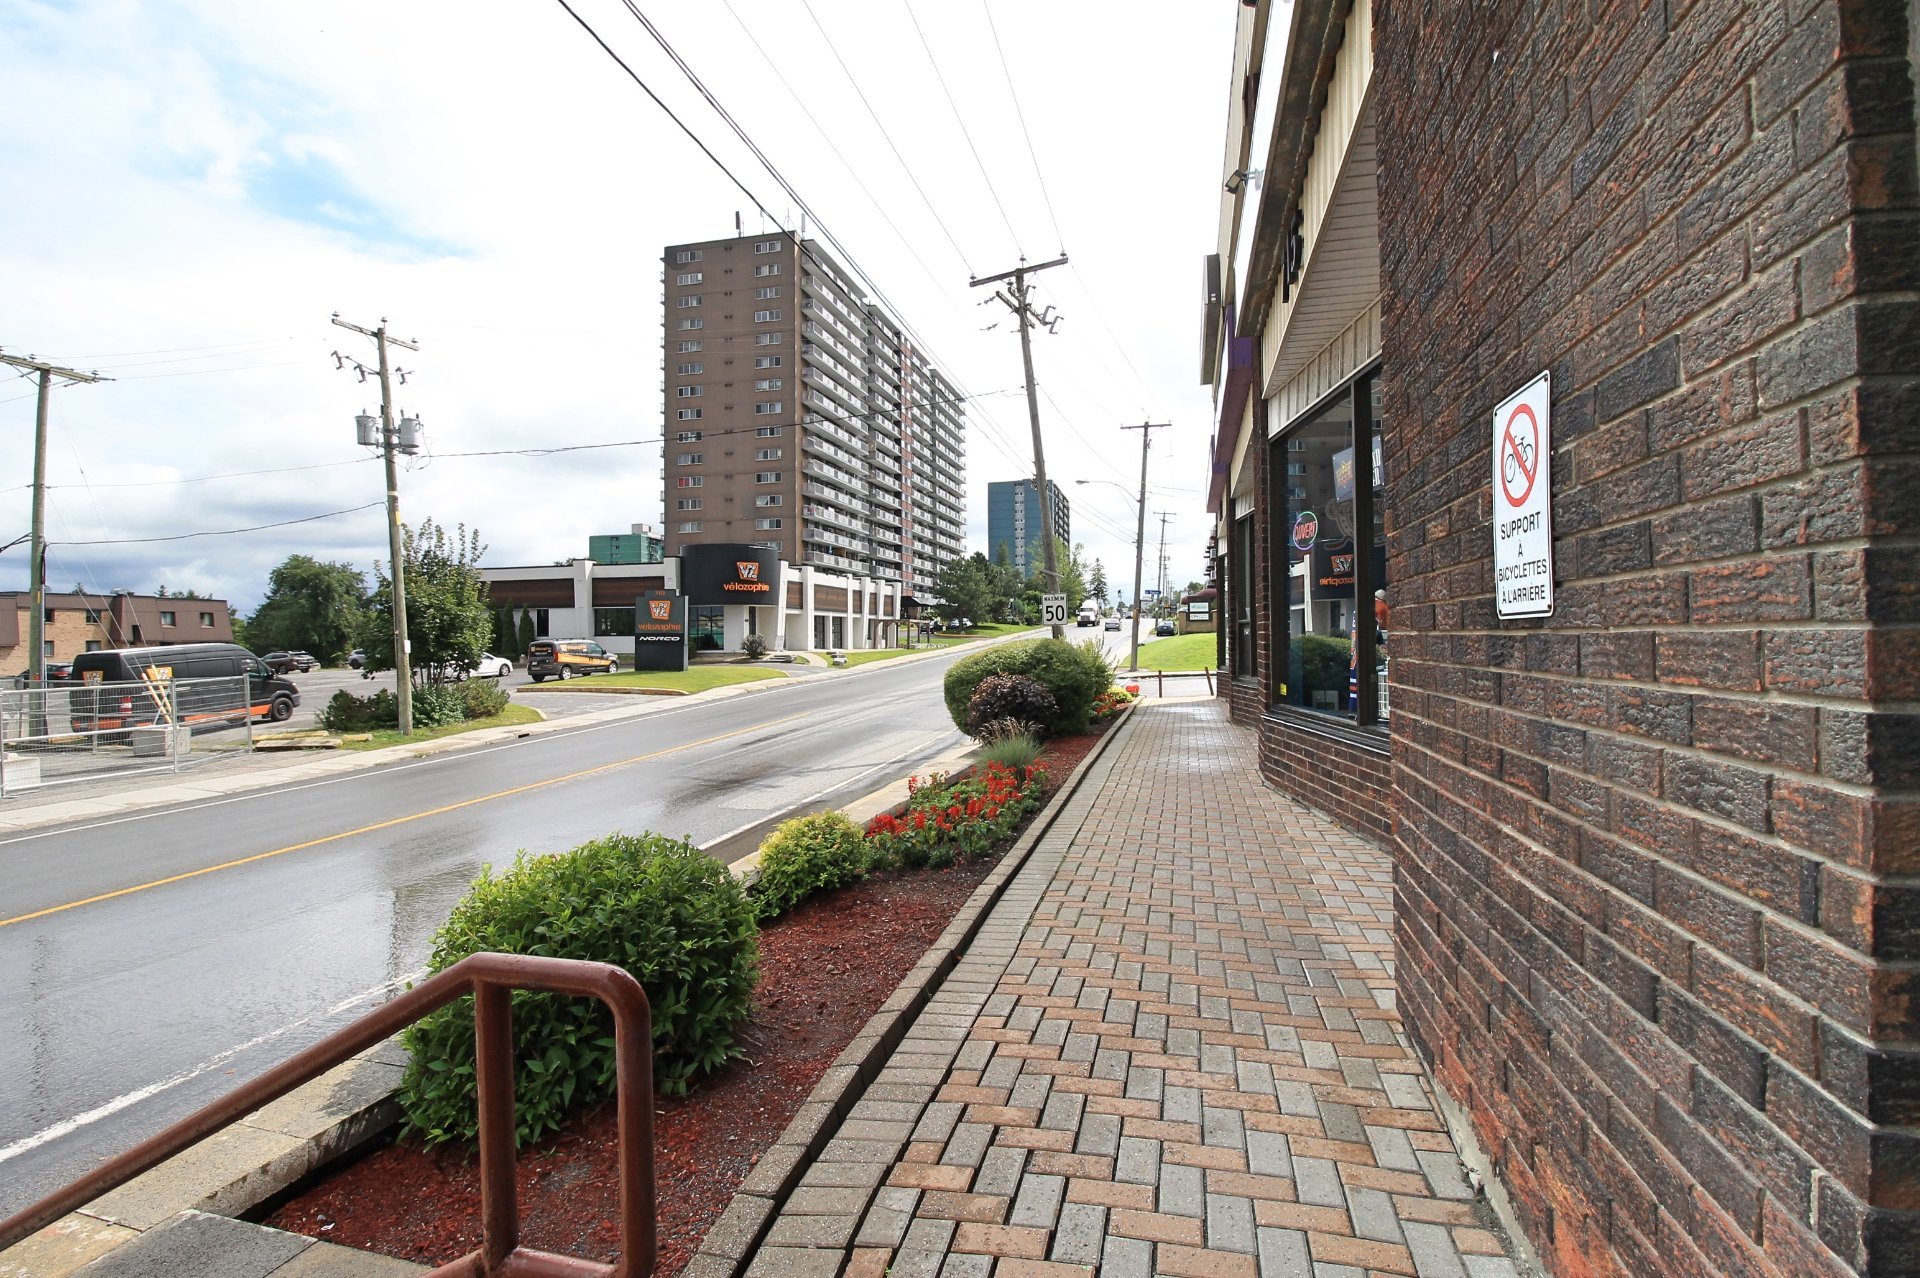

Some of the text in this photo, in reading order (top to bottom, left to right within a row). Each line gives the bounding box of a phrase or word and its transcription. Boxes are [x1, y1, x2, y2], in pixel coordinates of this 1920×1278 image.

[1295, 521, 1316, 541] OUVERT
[1500, 511, 1541, 540] SUPPORT
[1498, 558, 1547, 582] BICYCLETTES
[1045, 604, 1065, 622] 50
